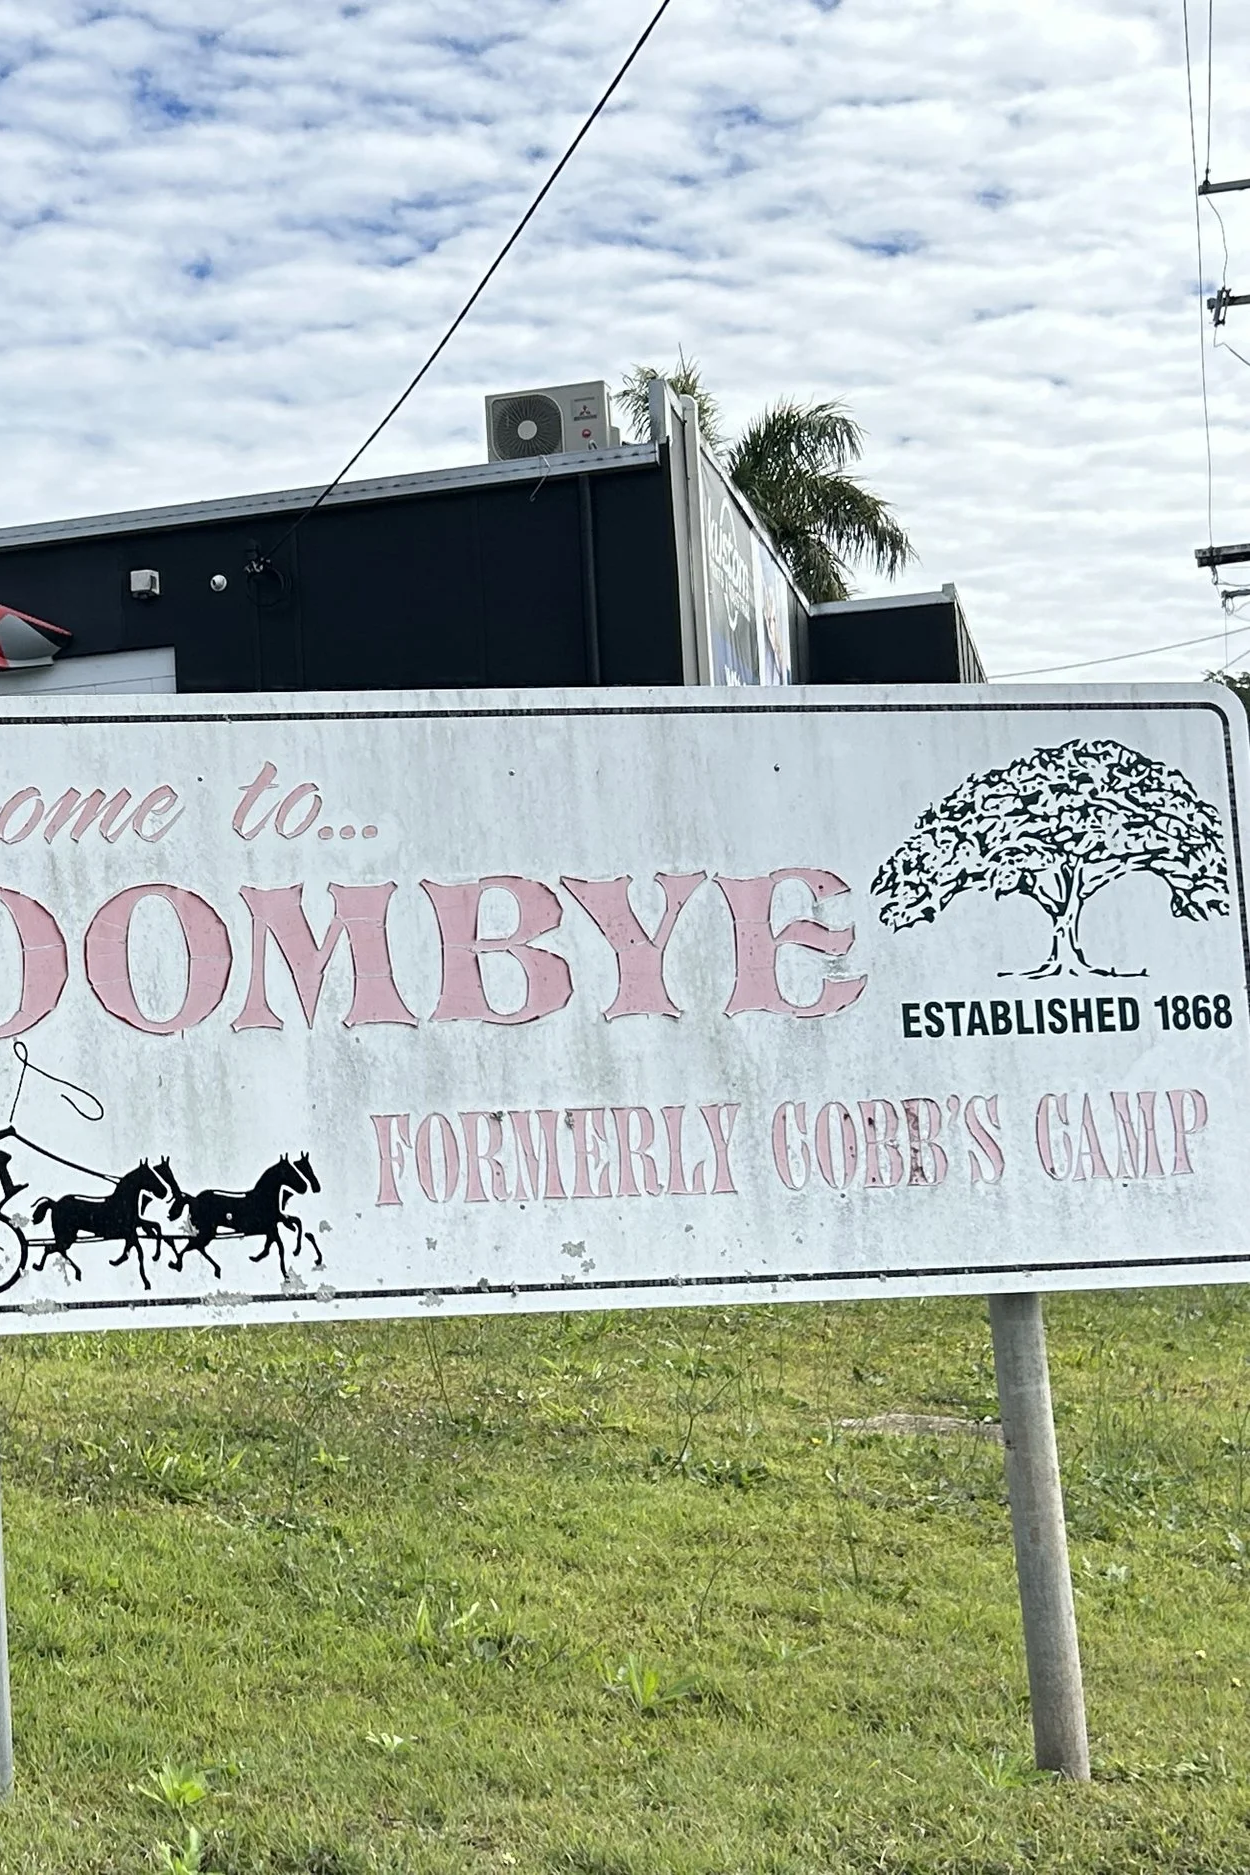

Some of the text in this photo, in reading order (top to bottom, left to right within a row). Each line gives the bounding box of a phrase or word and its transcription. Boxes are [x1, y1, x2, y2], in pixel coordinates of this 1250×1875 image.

[232, 761, 378, 841] to...
[902, 993, 1232, 1038] ESTABLISHED 1868
[369, 1088, 1209, 1207] FORMERLY COBB'S CAMP
